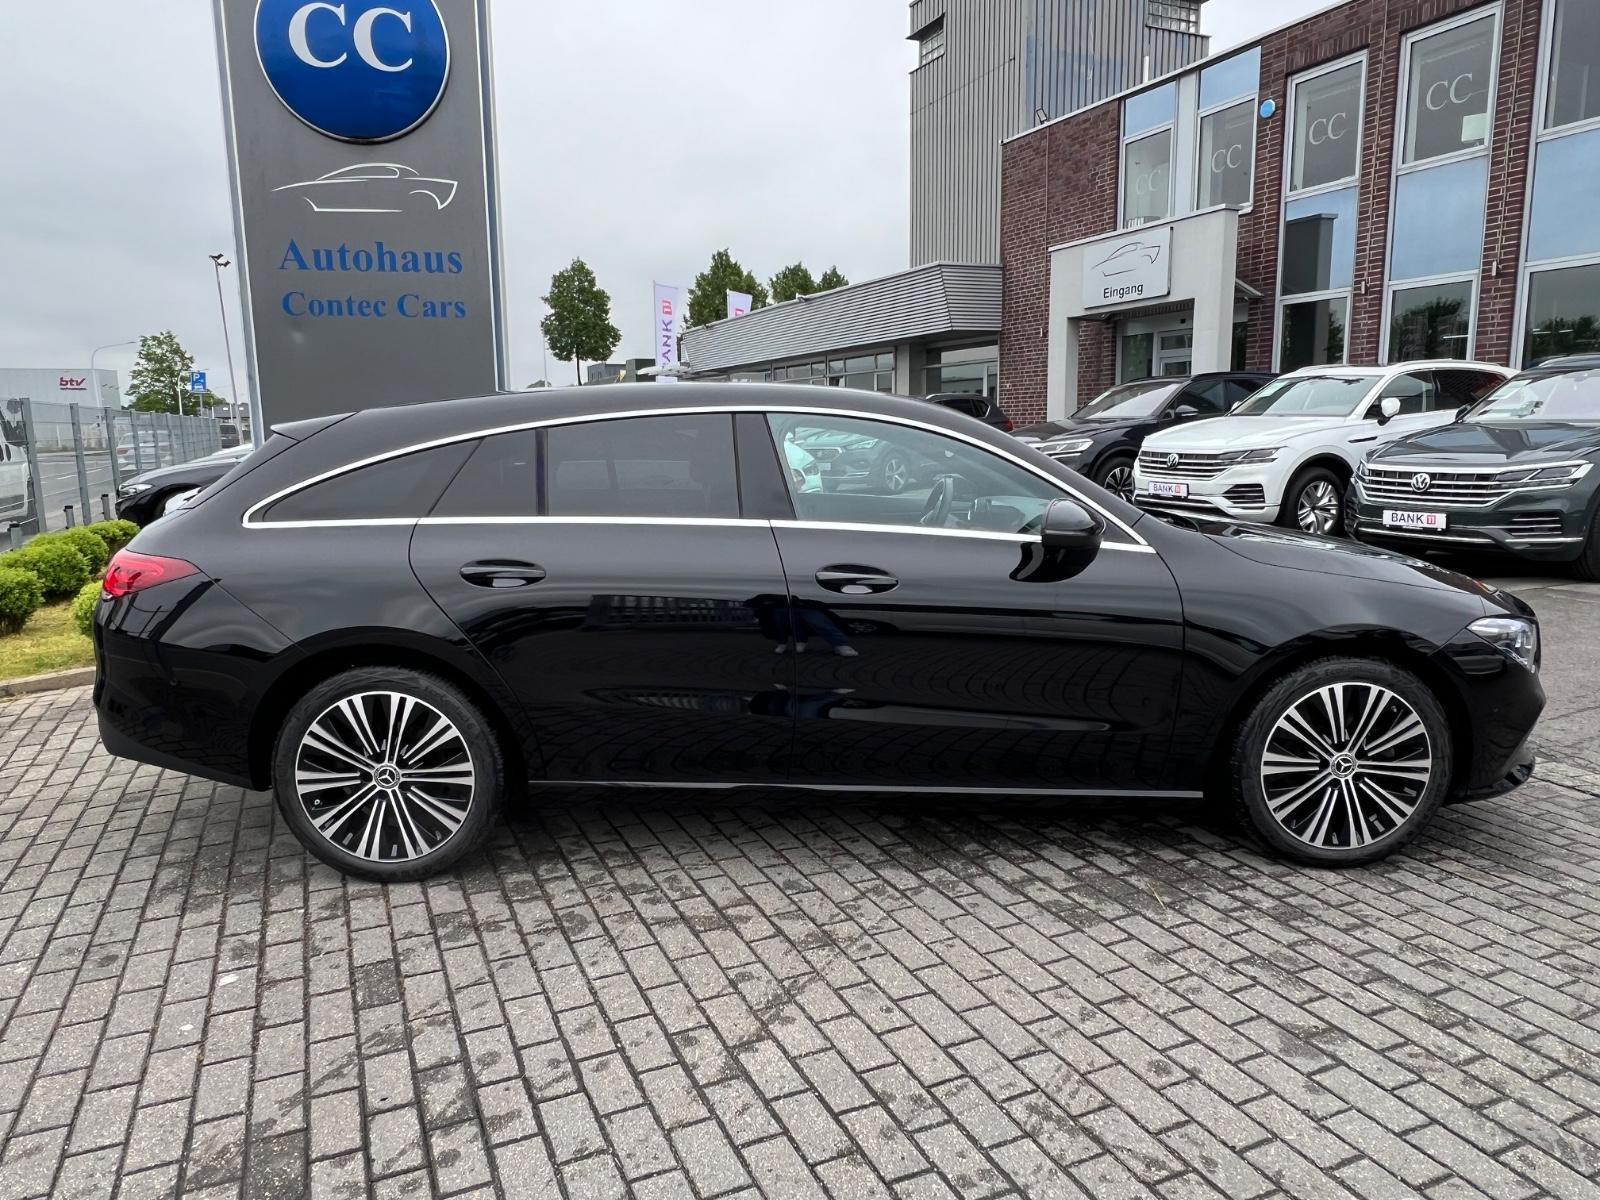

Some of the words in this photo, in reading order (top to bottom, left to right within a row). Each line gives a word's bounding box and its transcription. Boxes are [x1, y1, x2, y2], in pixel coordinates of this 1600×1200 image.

[288, 2, 413, 72] CC
[1426, 73, 1472, 110] CC
[1309, 112, 1346, 145] CC
[1211, 144, 1241, 173] CC
[279, 238, 463, 274] Autohaus
[282, 291, 388, 317] Contec
[397, 293, 466, 319] Cars
[1103, 284, 1143, 299] Eingang
[661, 319, 673, 368] ANK
[59, 376, 86, 387] btv
[193, 373, 200, 382] P
[1153, 483, 1174, 494] BANK
[1391, 512, 1425, 525] BANK
